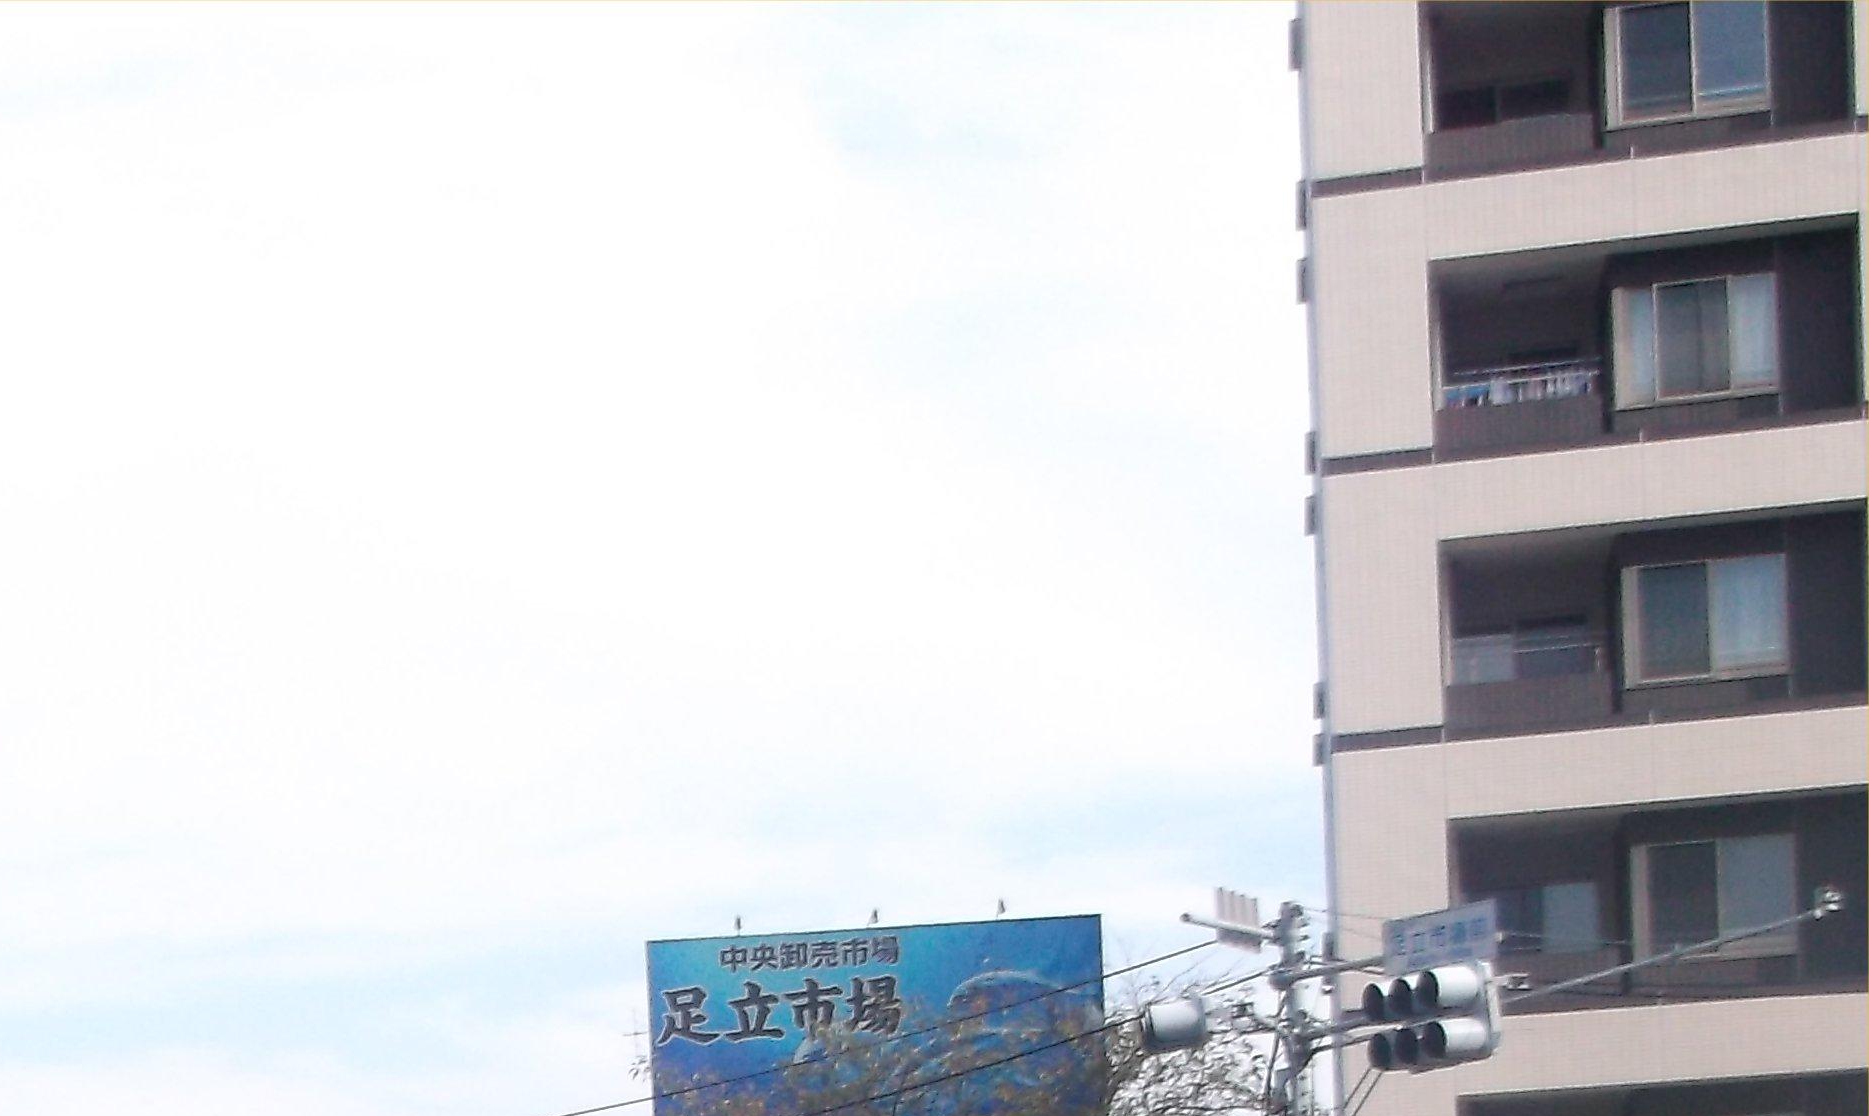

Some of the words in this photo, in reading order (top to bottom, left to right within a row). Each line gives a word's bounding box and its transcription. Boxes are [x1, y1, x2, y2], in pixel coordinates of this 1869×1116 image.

[720, 936, 899, 972] 中央卸売市場
[658, 974, 902, 1046] 足立市場
